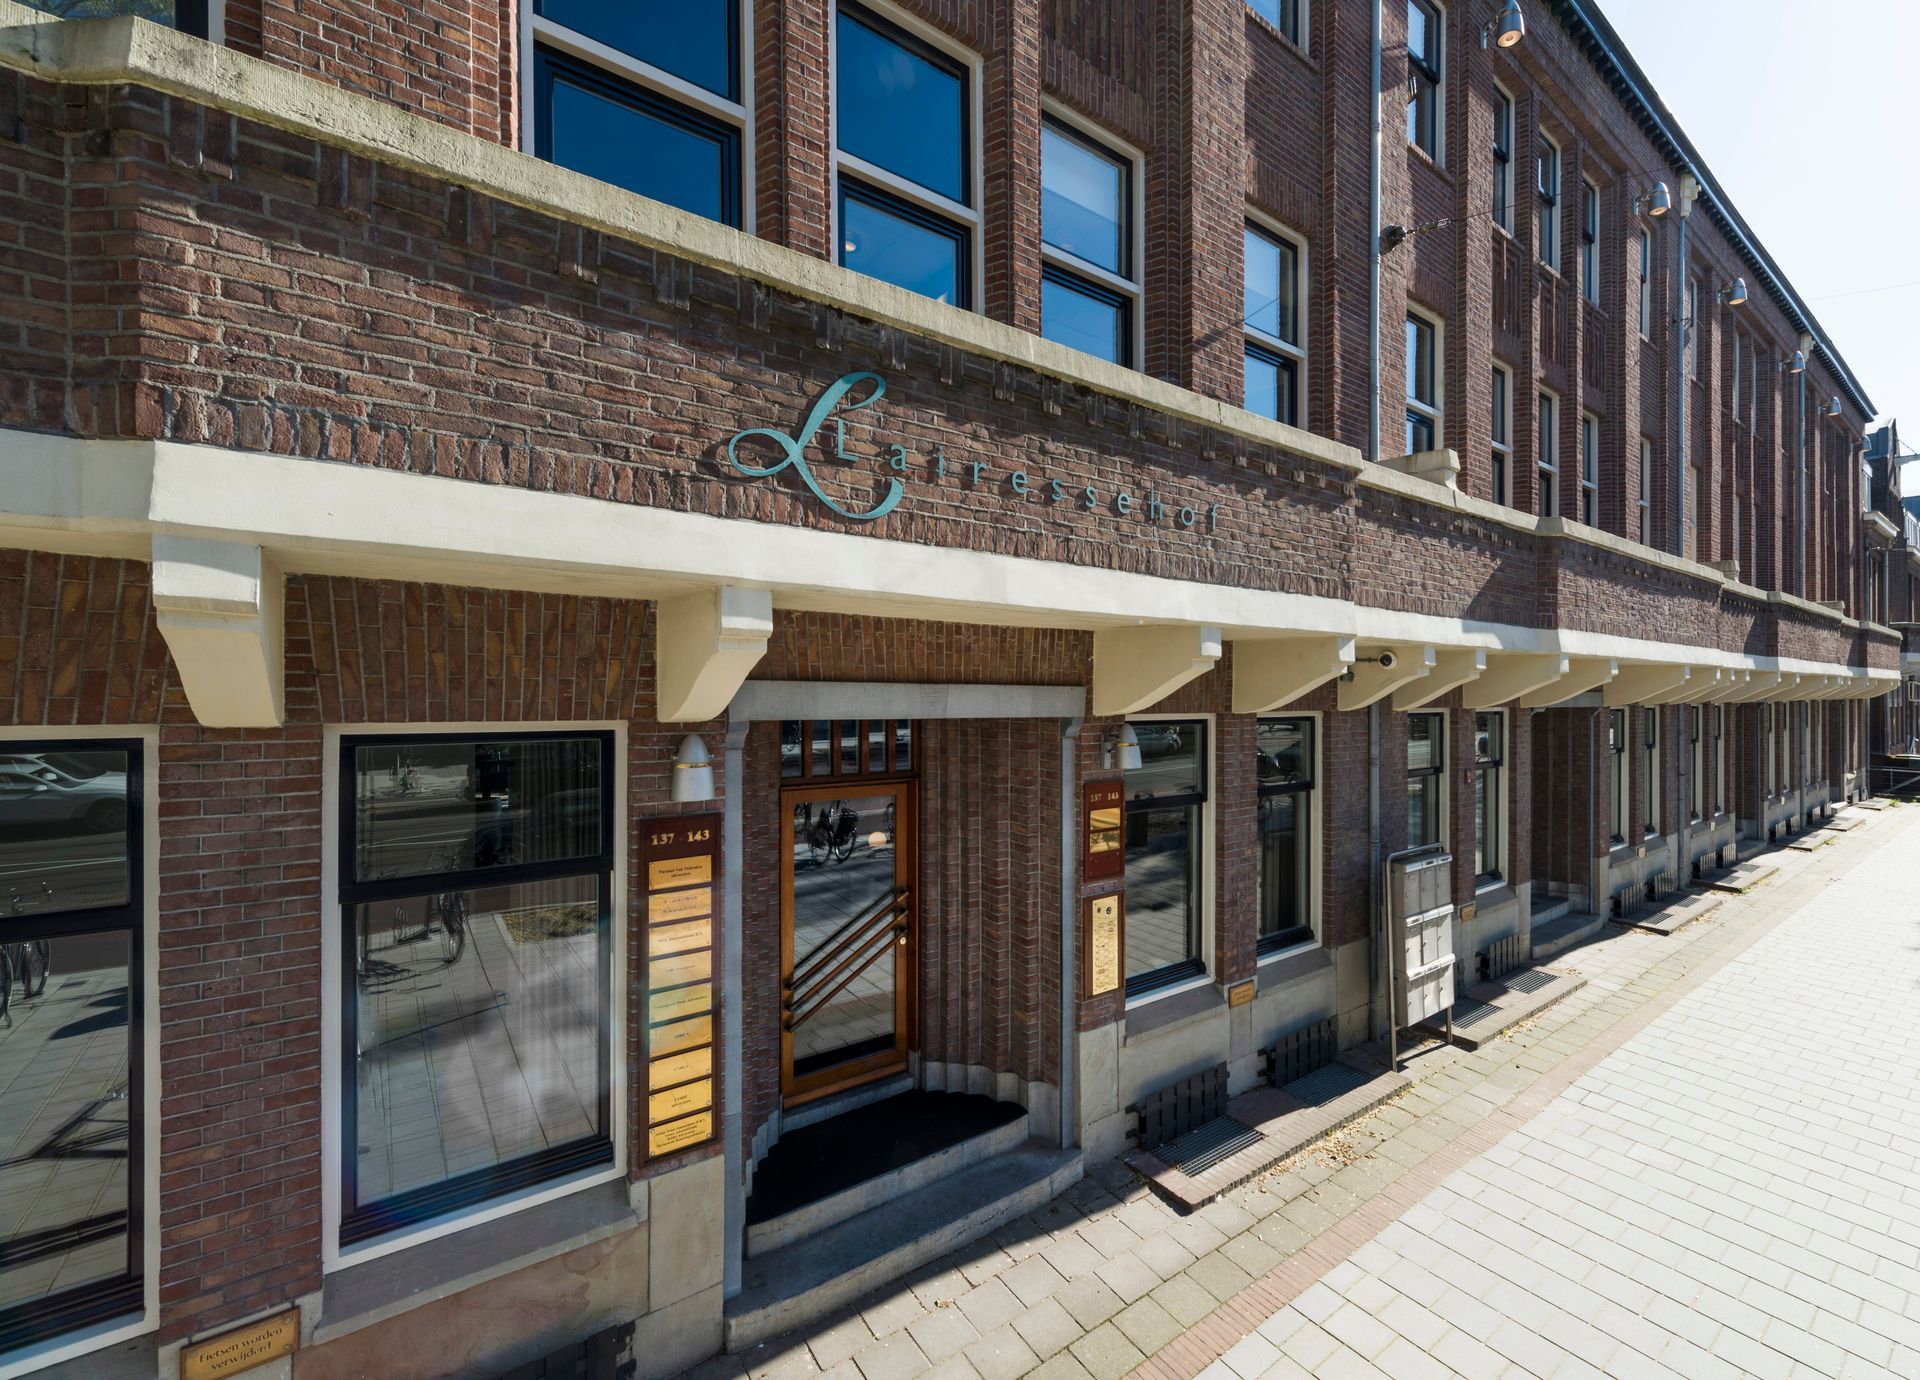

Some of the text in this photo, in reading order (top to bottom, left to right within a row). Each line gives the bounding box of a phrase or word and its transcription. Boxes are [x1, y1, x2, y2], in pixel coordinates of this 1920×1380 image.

[836, 418, 1221, 530] Lairessehof
[651, 829, 710, 846] 137 143
[200, 1328, 282, 1362] Fietsen worden
